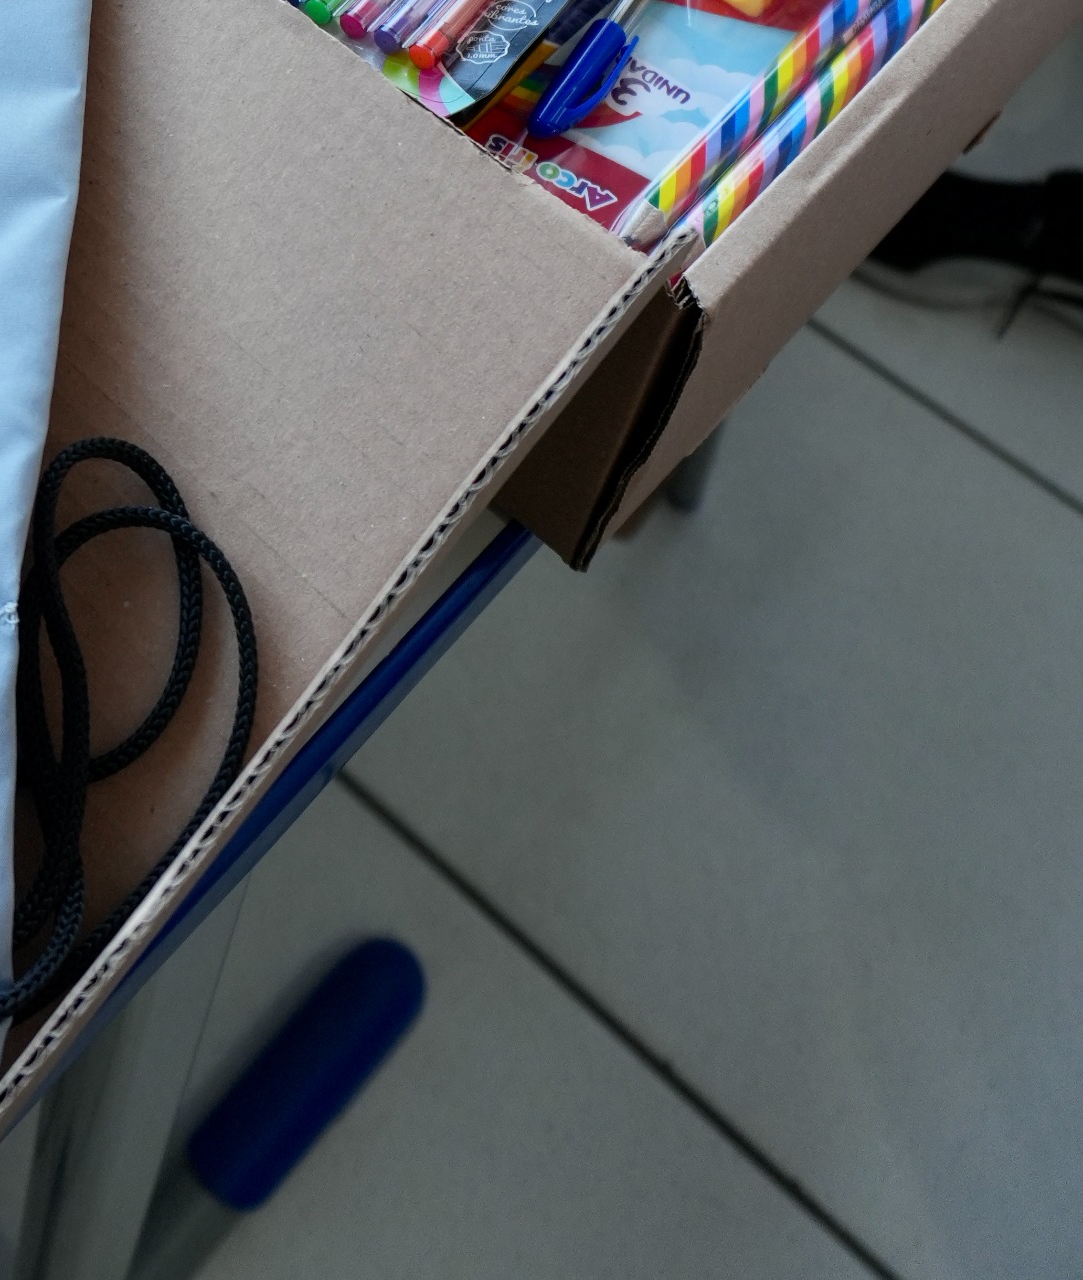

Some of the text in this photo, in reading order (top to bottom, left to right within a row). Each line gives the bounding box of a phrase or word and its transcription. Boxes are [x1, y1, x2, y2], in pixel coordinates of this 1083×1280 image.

[496, 1, 527, 15] cores
[468, 33, 496, 45] ponta
[611, 76, 652, 106] 3
[626, 55, 691, 105] UNIDA
